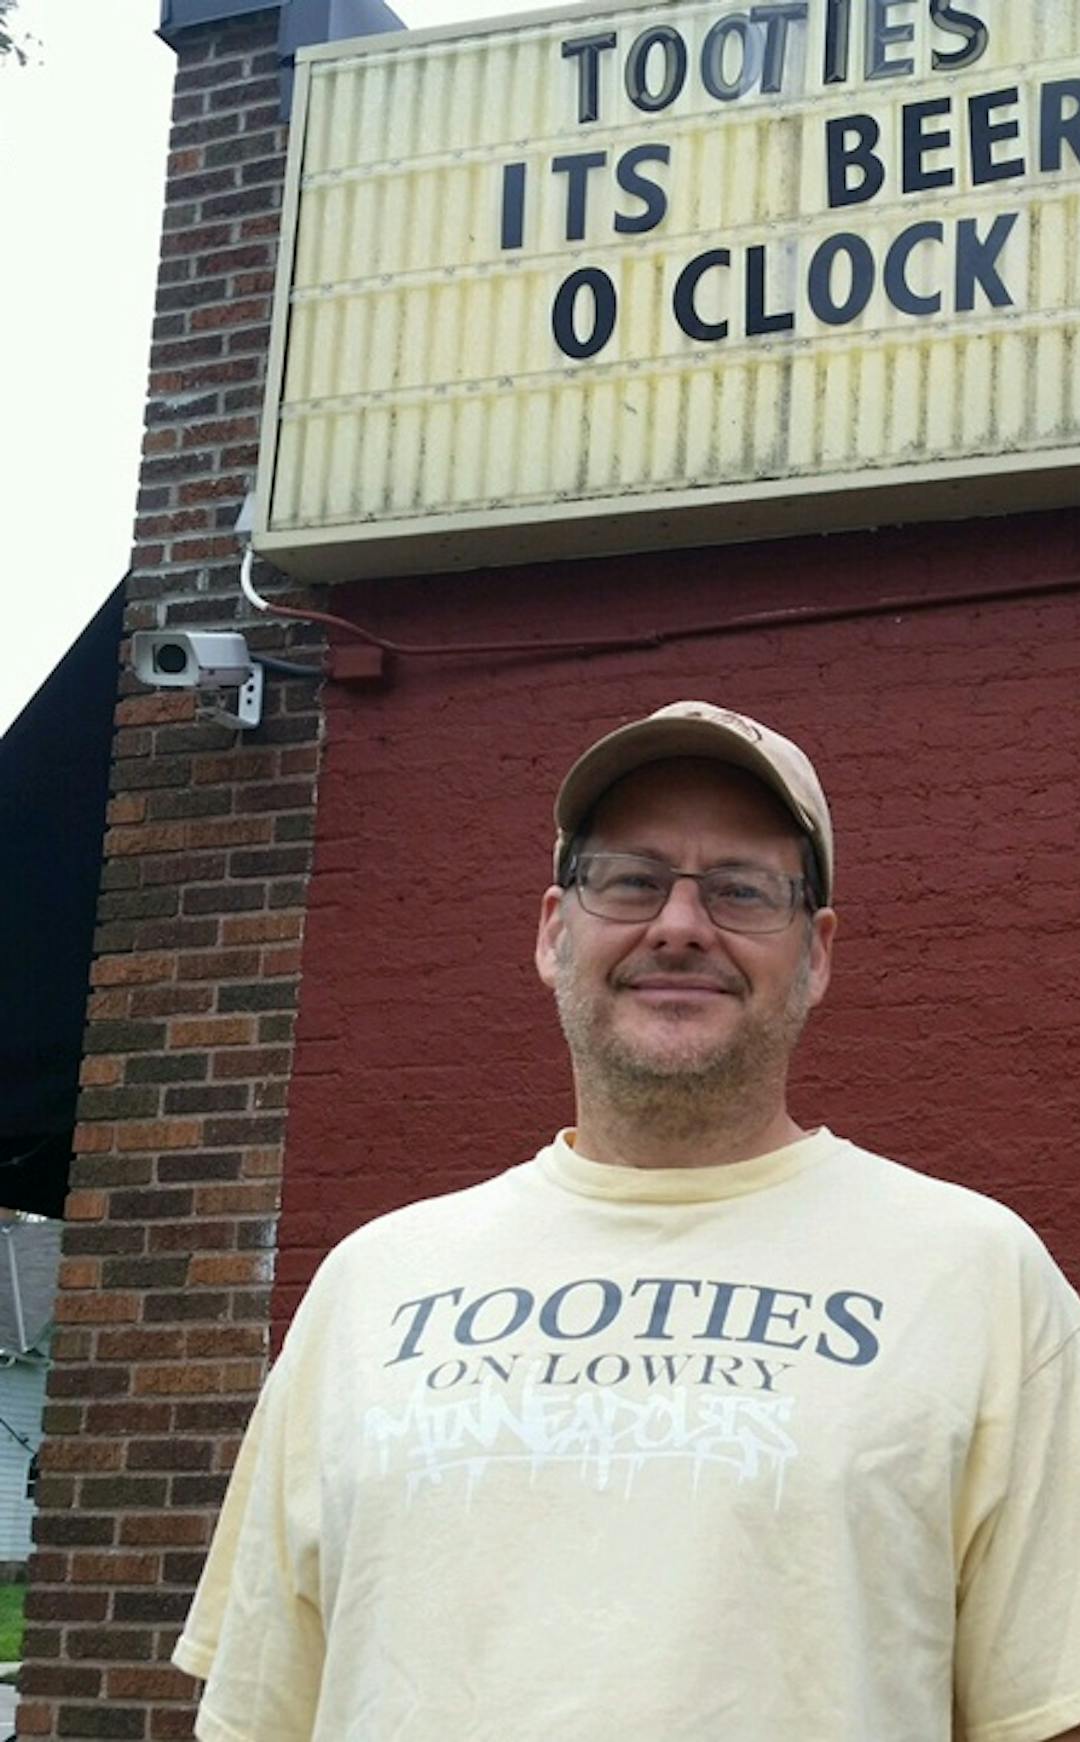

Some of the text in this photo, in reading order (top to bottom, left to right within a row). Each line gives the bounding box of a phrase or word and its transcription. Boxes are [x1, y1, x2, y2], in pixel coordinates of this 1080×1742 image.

[561, 0, 989, 123] TOOTIES
[501, 144, 670, 249] ITS
[552, 213, 1019, 359] O CLOCK
[383, 1278, 884, 1367] TOOTIES
[425, 1353, 798, 1392] ON LOWRY
